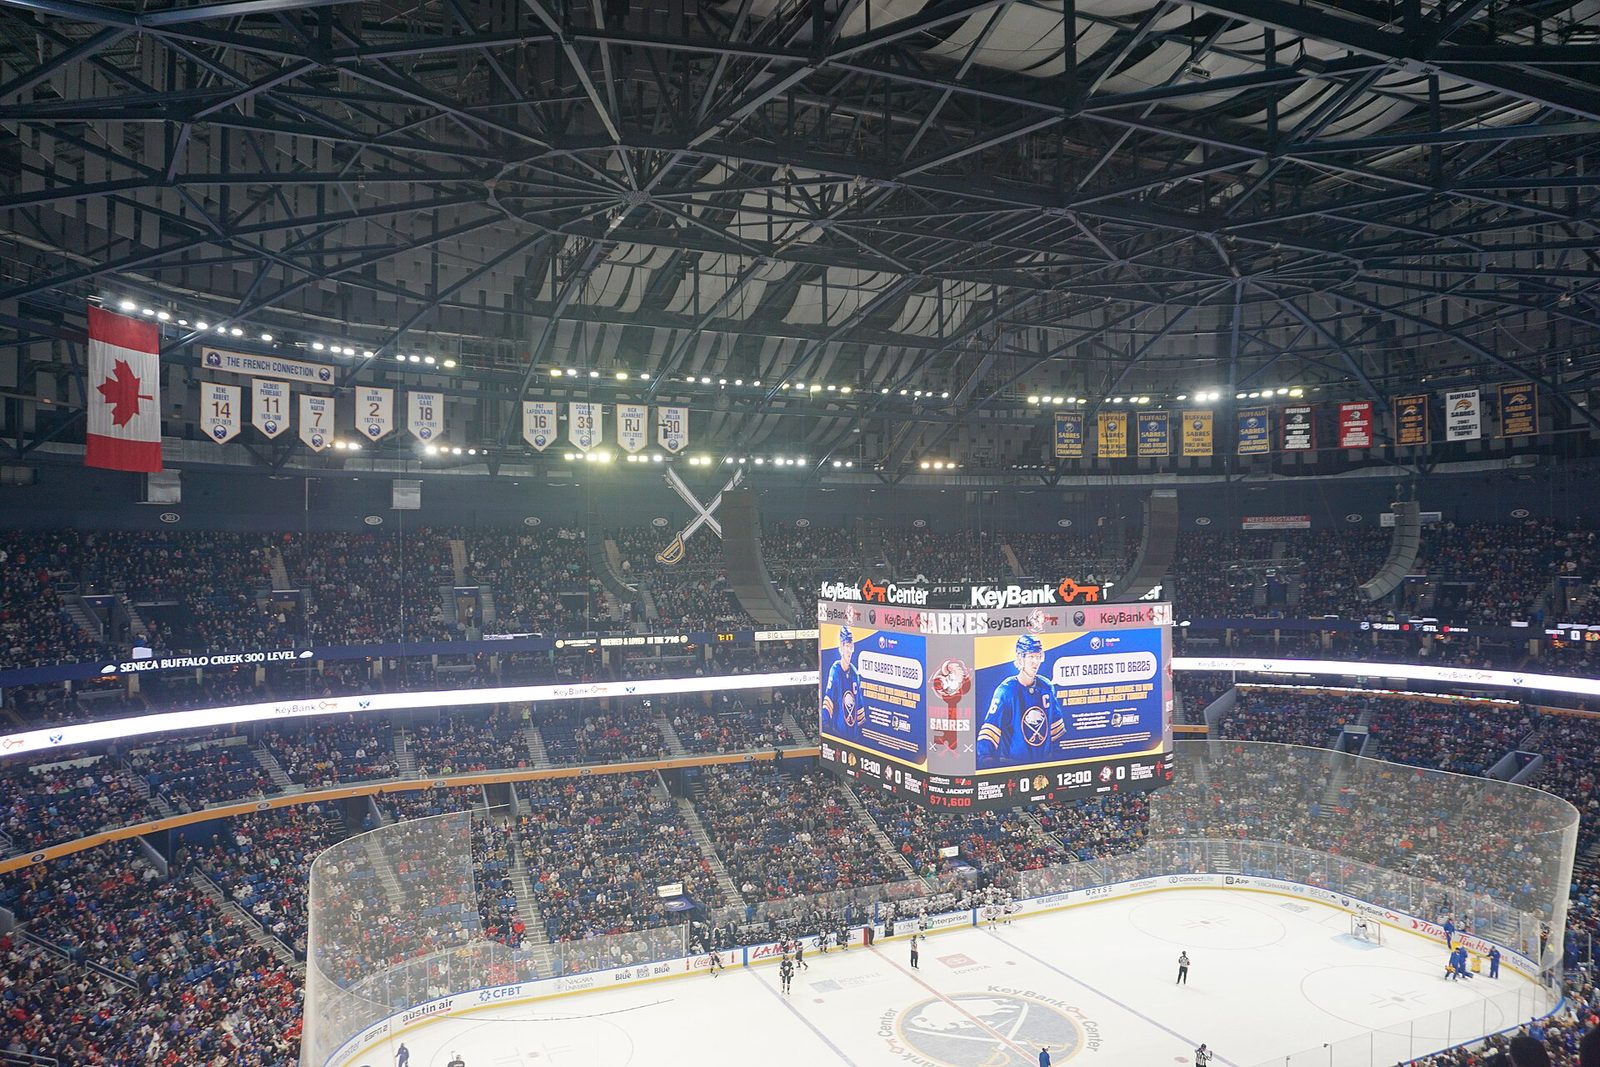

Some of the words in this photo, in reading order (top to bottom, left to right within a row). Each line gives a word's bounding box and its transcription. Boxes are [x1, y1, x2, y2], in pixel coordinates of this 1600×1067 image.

[227, 356, 240, 366] THE
[243, 359, 270, 370] FRENCH
[272, 362, 314, 376] CONNECTION
[212, 401, 230, 418] 14
[263, 397, 278, 413] 11
[370, 402, 380, 416] 2
[1505, 404, 1532, 412] SABRES
[313, 412, 322, 426] 7
[419, 406, 432, 420] 18
[534, 416, 547, 428] 16
[578, 416, 593, 428] 39
[625, 419, 640, 432] RJ
[666, 420, 680, 433] 30
[821, 581, 862, 601] KeyBank
[887, 584, 929, 605] Center
[971, 584, 1056, 609] KeyBank
[885, 614, 914, 627] KeyBank
[920, 612, 988, 634] SABRES
[1100, 612, 1144, 625] KeyBank
[120, 661, 159, 672] SENECA
[161, 657, 209, 668] BUFFALO
[210, 654, 244, 665] CREEK
[245, 653, 265, 662] 300
[267, 651, 297, 661] LEVEL
[862, 659, 874, 670] TEXT
[874, 662, 894, 675] SABRES
[895, 666, 901, 676] TO
[1060, 665, 1080, 678] TEXT
[1082, 662, 1114, 676] SABRES
[1116, 662, 1125, 673] TO
[1127, 661, 1150, 673] 86225
[554, 688, 588, 697] KeyBank
[1042, 694, 1050, 708] C
[275, 704, 316, 714] KeyBank
[930, 718, 970, 731] SABRES
[842, 751, 847, 763] 0
[860, 758, 880, 774] 12:00
[895, 770, 901, 784] 0
[1020, 778, 1030, 792] 0
[1056, 770, 1092, 786] 12:00
[1116, 766, 1126, 780] 0
[930, 795, 971, 808] $71,600
[1356, 904, 1383, 916] KeyBank
[753, 947, 771, 958] LA
[654, 966, 670, 974] Blue
[952, 966, 991, 975] TOYOTA
[493, 986, 522, 998] CFBT
[987, 985, 1065, 1008] KeyBank
[402, 1005, 436, 1022] austin
[438, 999, 453, 1009] air
[878, 1008, 899, 1037] Center
[1083, 1020, 1104, 1051] Center
